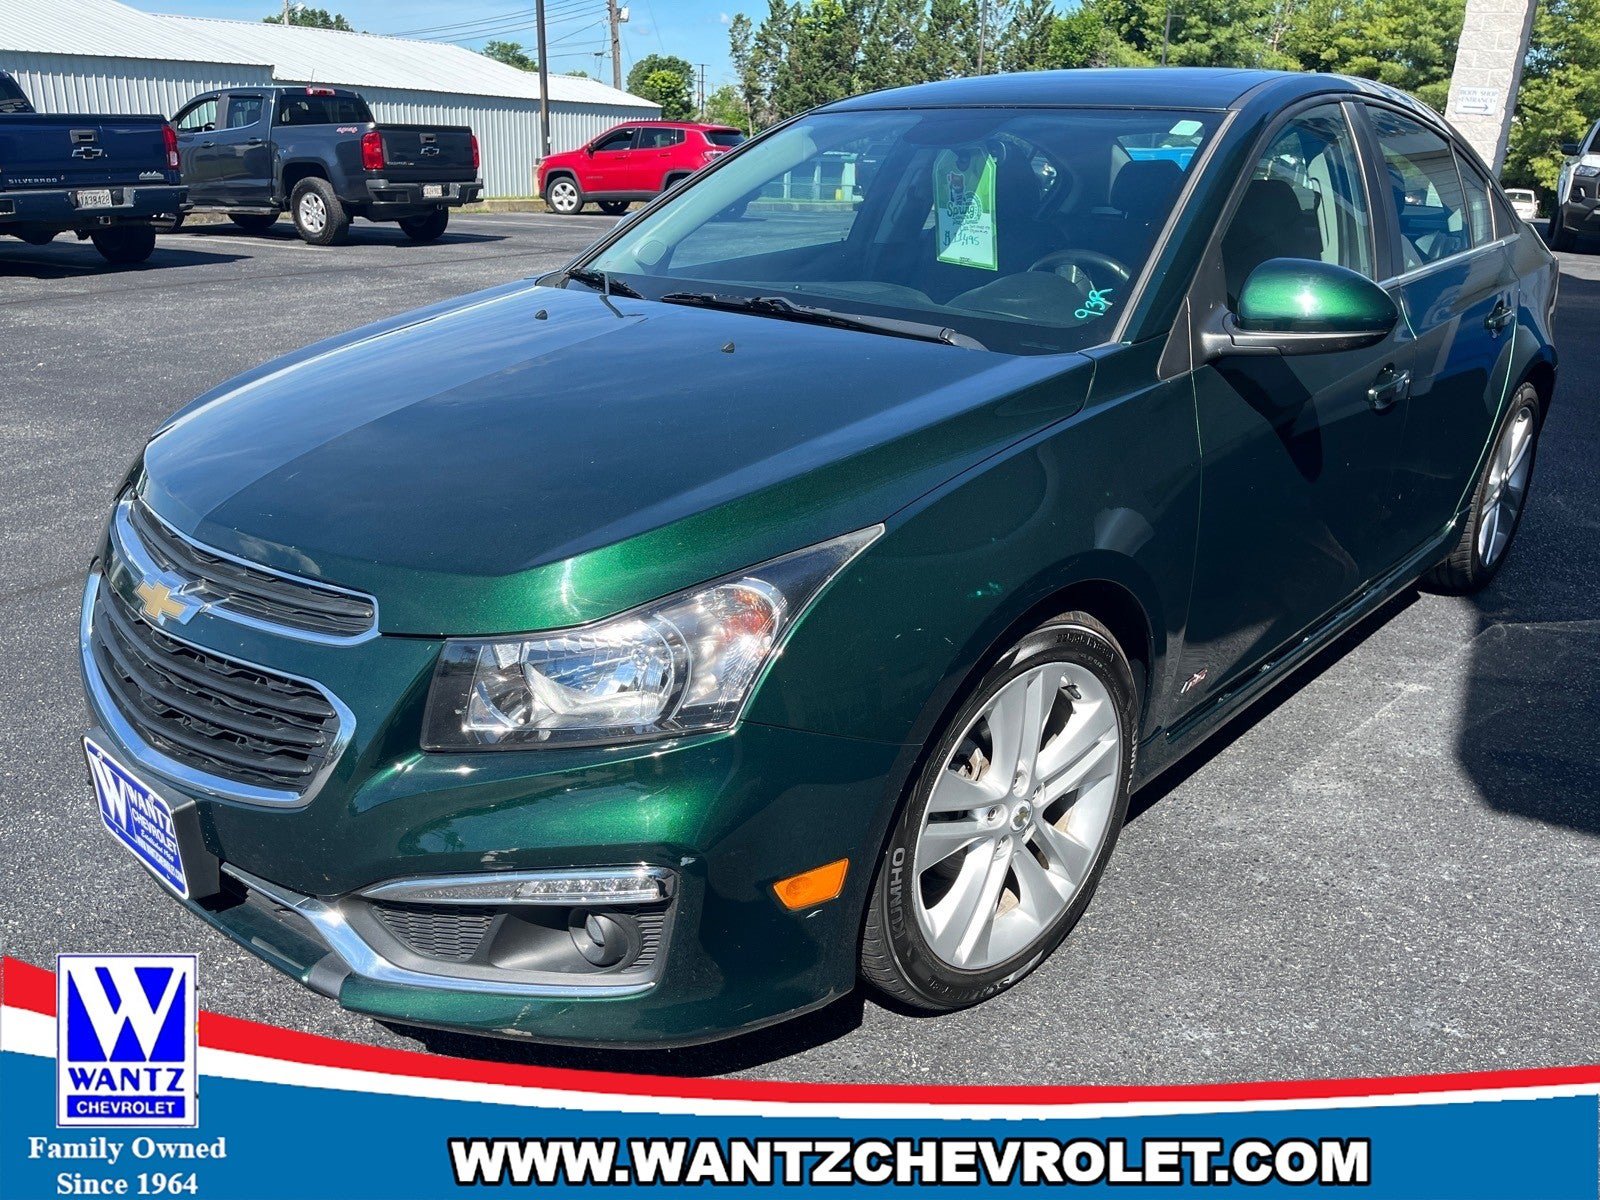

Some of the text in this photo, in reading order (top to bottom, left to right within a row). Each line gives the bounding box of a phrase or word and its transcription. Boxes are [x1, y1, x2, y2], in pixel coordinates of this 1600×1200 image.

[8, 177, 58, 185] SILVERADO
[1074, 280, 1114, 319] 93R
[125, 781, 176, 840] WANTZ
[890, 847, 906, 940] KUMHO
